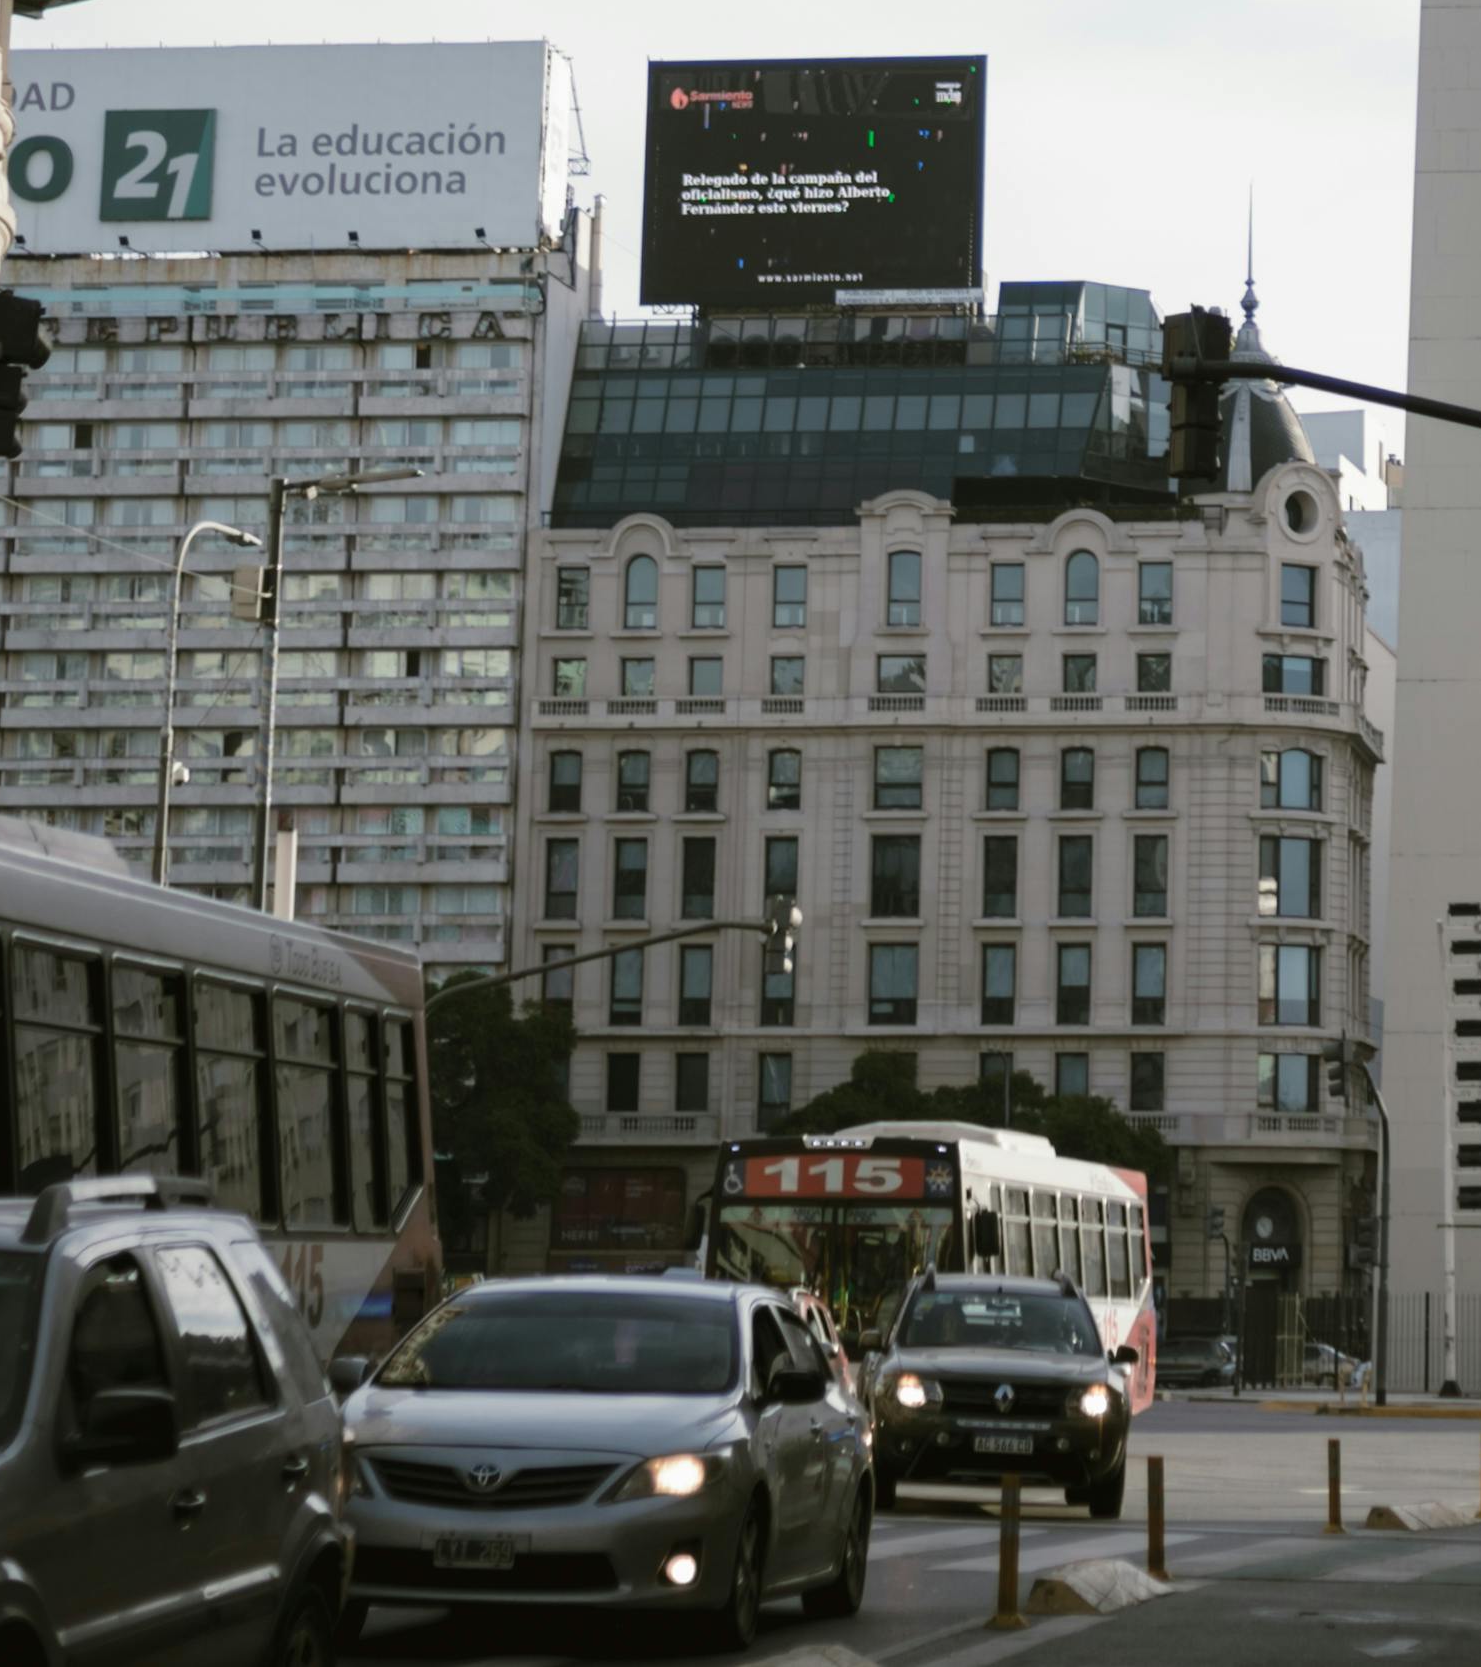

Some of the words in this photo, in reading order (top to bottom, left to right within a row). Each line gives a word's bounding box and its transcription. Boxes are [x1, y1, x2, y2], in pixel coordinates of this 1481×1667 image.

[8, 81, 76, 112] AD
[689, 89, 754, 102] Sarmiento
[256, 126, 298, 157] La
[311, 122, 507, 157] educación
[112, 130, 200, 219] 21
[253, 162, 468, 198] evoluciona
[682, 174, 748, 188] Relegado
[751, 174, 769, 186] de
[772, 173, 786, 185] la
[789, 172, 852, 188] campaña
[855, 171, 878, 184] del
[681, 187, 764, 202] oficialismo,
[767, 185, 801, 202] ¿qué
[804, 185, 834, 199] hizo
[837, 184, 890, 198] Alberto
[681, 200, 755, 215] Fernández
[758, 202, 789, 214] este
[792, 200, 850, 215] viernes?
[757, 271, 864, 283] www.sarmiento.net
[763, 1157, 905, 1194] 115
[1252, 1245, 1290, 1263] BBVA
